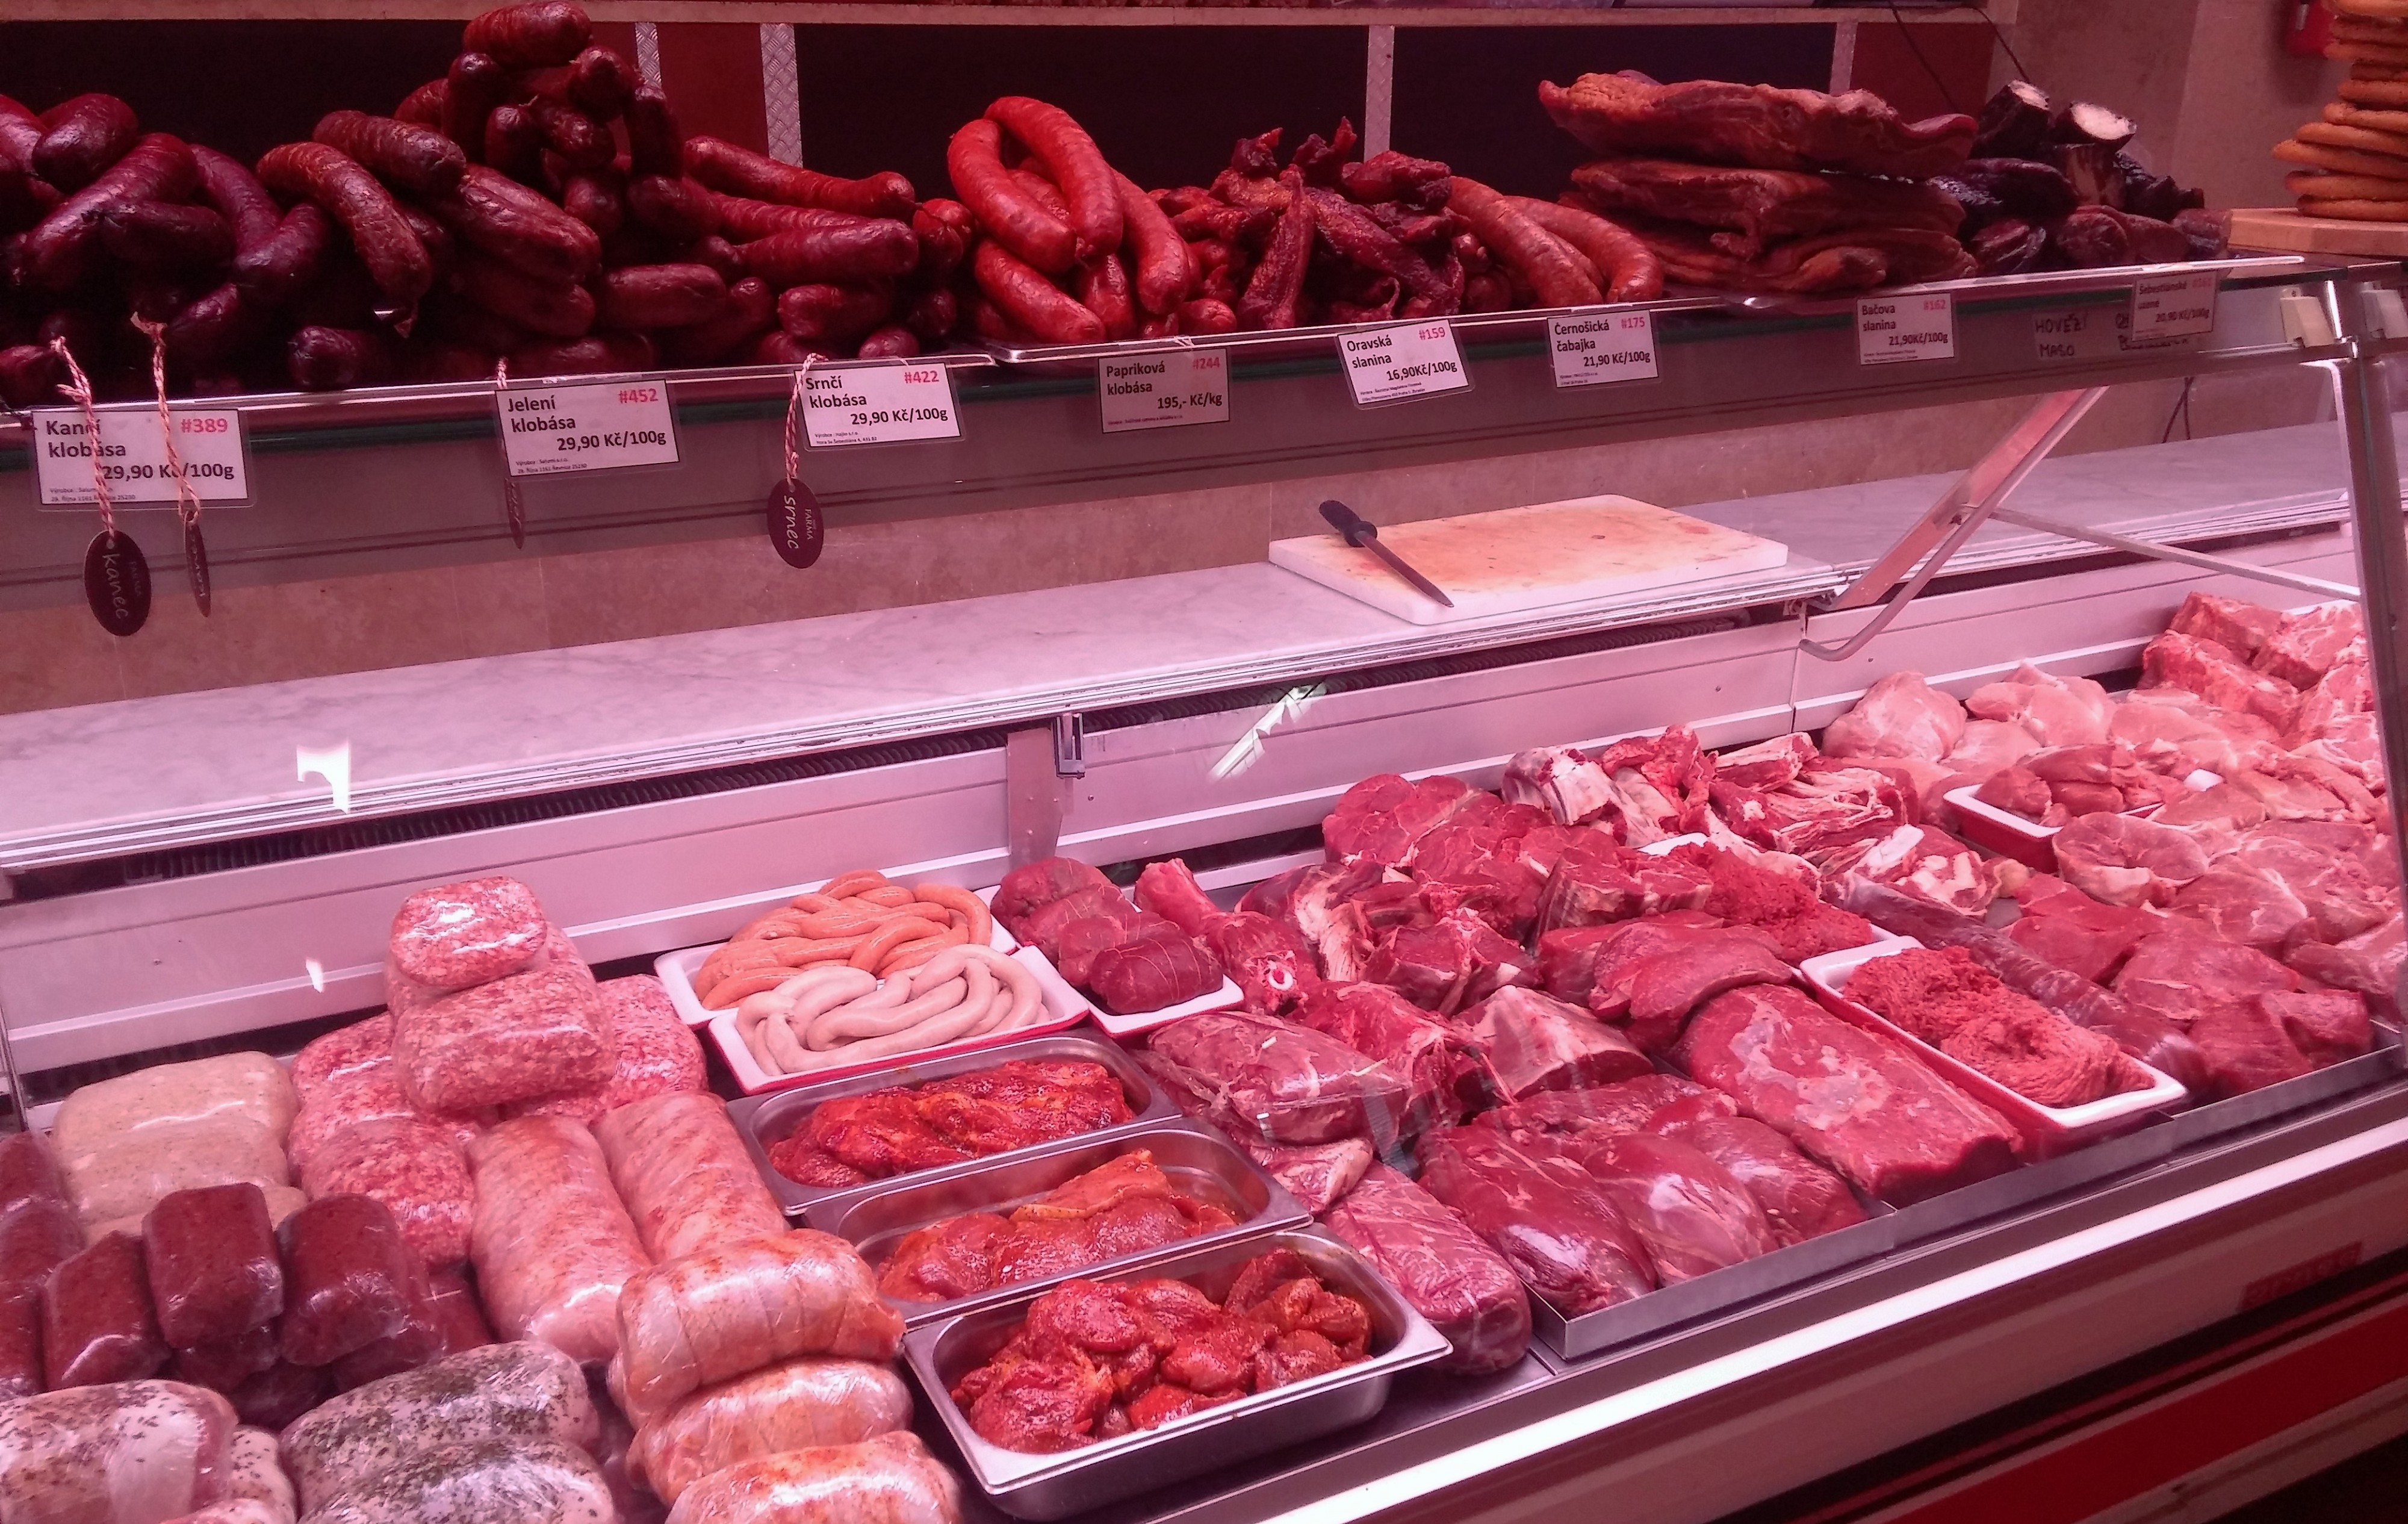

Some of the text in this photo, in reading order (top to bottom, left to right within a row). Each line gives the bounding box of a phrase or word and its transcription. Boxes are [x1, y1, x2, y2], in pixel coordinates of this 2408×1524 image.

[1862, 303, 1896, 316] Bačova
[1554, 319, 1610, 335] Černošická
[1621, 316, 1645, 329] #175
[1863, 320, 1896, 331] slanina
[1419, 327, 1445, 340] #159
[1347, 334, 1392, 352] Oravská
[1557, 338, 1596, 353] čabajka
[1193, 357, 1220, 370] #244
[1352, 354, 1392, 369] slanina
[1583, 350, 1651, 368] 21,90 Kč/100g
[904, 370, 939, 384] #422
[1106, 361, 1165, 378] Papriková
[1386, 361, 1457, 381] 16,90Kč/100g
[805, 375, 843, 390] Srnčí
[1107, 381, 1153, 396] klobása
[507, 394, 556, 412] Jelení
[618, 388, 659, 404] #452
[809, 393, 867, 409] klobása
[1158, 392, 1223, 409] 195,- Kč/kg
[511, 415, 576, 432] klobása
[850, 407, 948, 426] 29,90 Kč/100g
[46, 419, 101, 435] Kaní
[181, 418, 228, 433] #389
[49, 441, 126, 458] klobása
[557, 431, 666, 452] 29,90 Kč/100g
[101, 465, 153, 482] 29,90
[784, 495, 799, 549] srnec
[805, 509, 814, 540] FARMA
[102, 553, 128, 619] kanec
